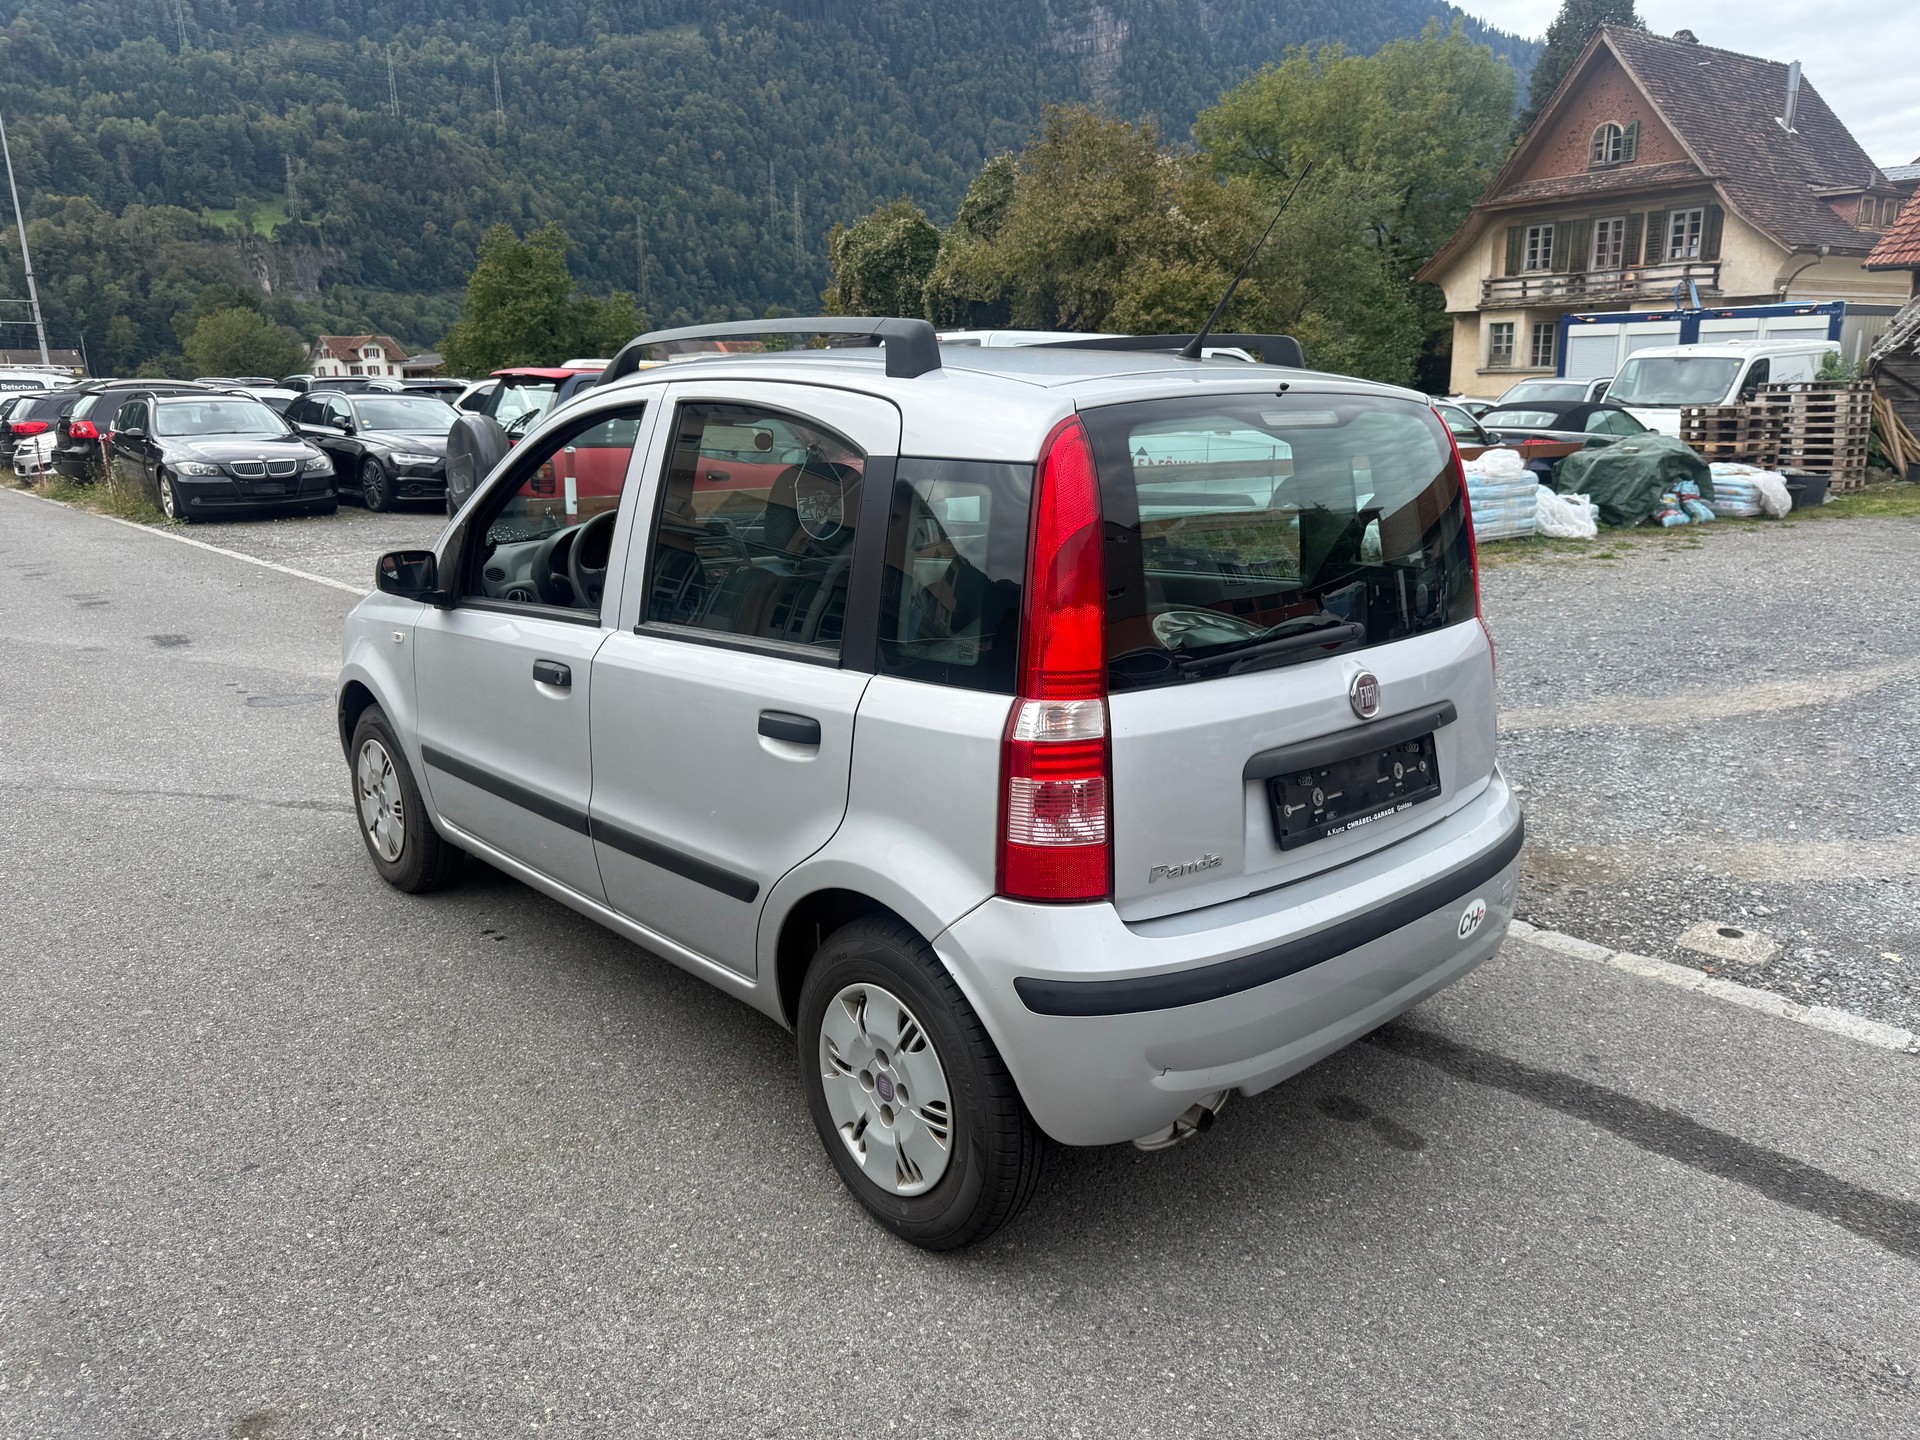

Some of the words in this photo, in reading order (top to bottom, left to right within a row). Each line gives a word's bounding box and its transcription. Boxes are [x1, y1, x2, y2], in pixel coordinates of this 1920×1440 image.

[1, 383, 38, 391] Betschart
[1359, 684, 1376, 708] FIAT
[1149, 853, 1223, 883] Panda
[1460, 906, 1480, 936] CH
